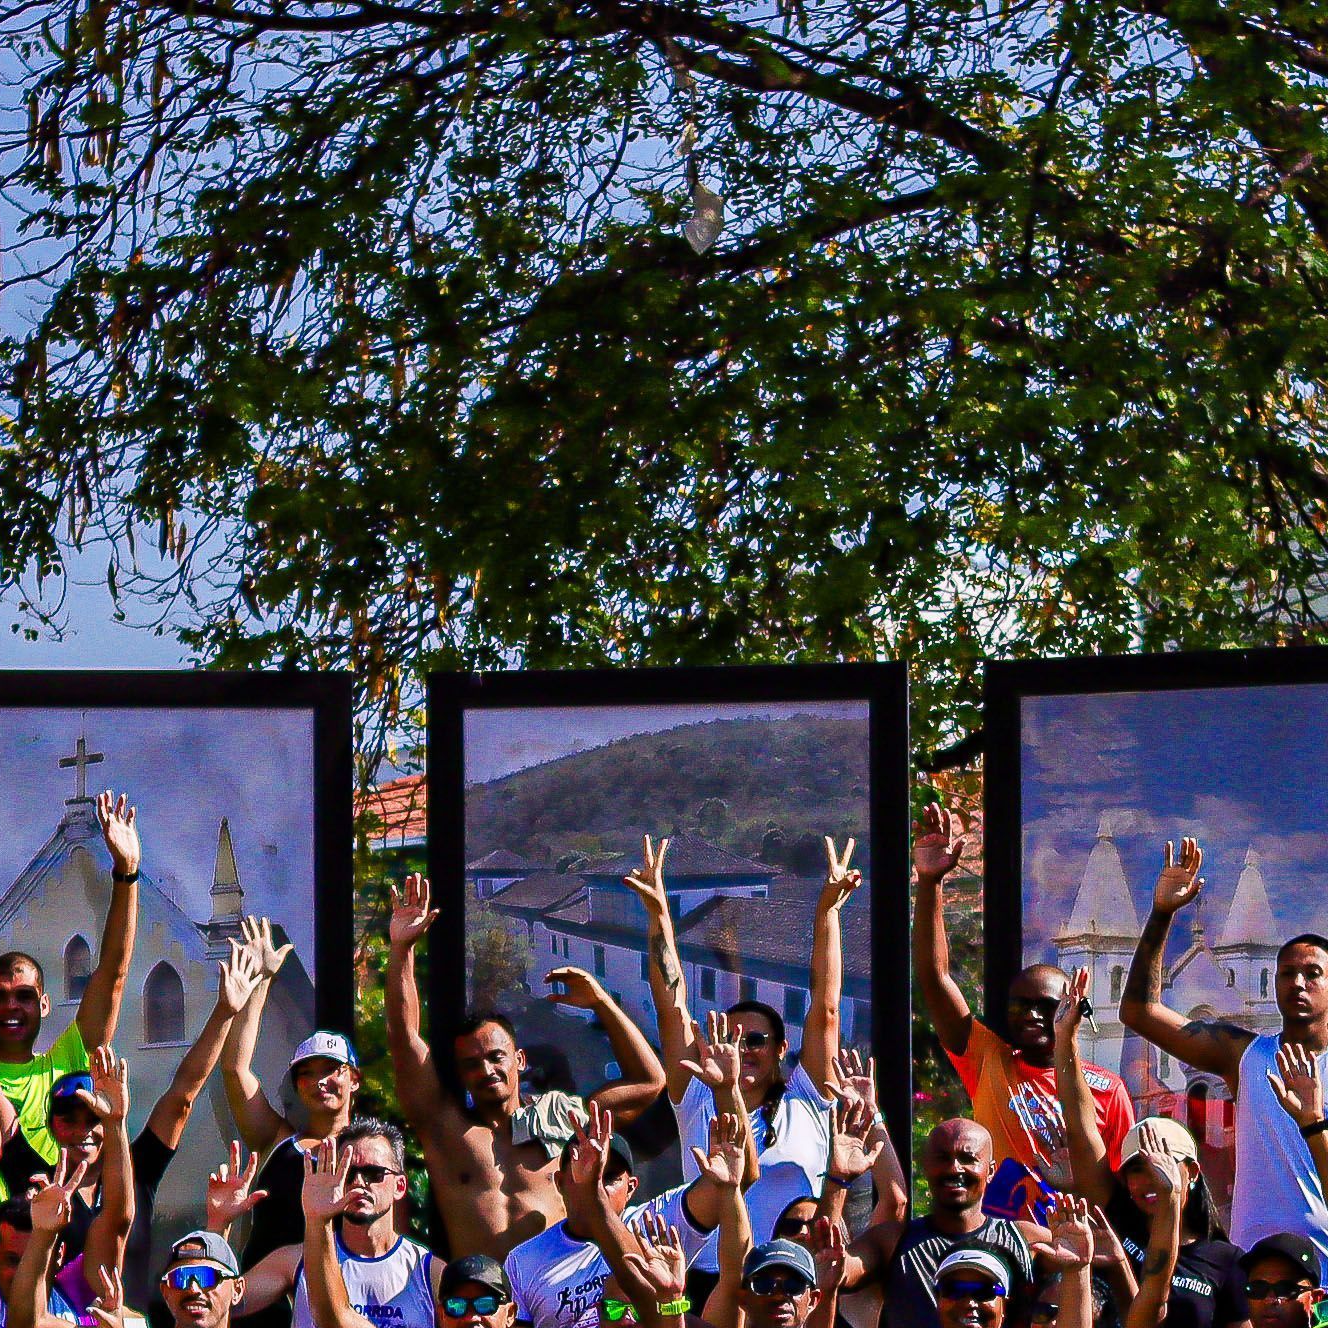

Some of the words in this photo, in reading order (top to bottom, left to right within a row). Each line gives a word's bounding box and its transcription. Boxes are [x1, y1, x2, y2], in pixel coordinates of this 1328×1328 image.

[1123, 1237, 1138, 1255] VAI
[1172, 1276, 1212, 1296] ENTÁRIO
[353, 1303, 404, 1320] ORRIDA
